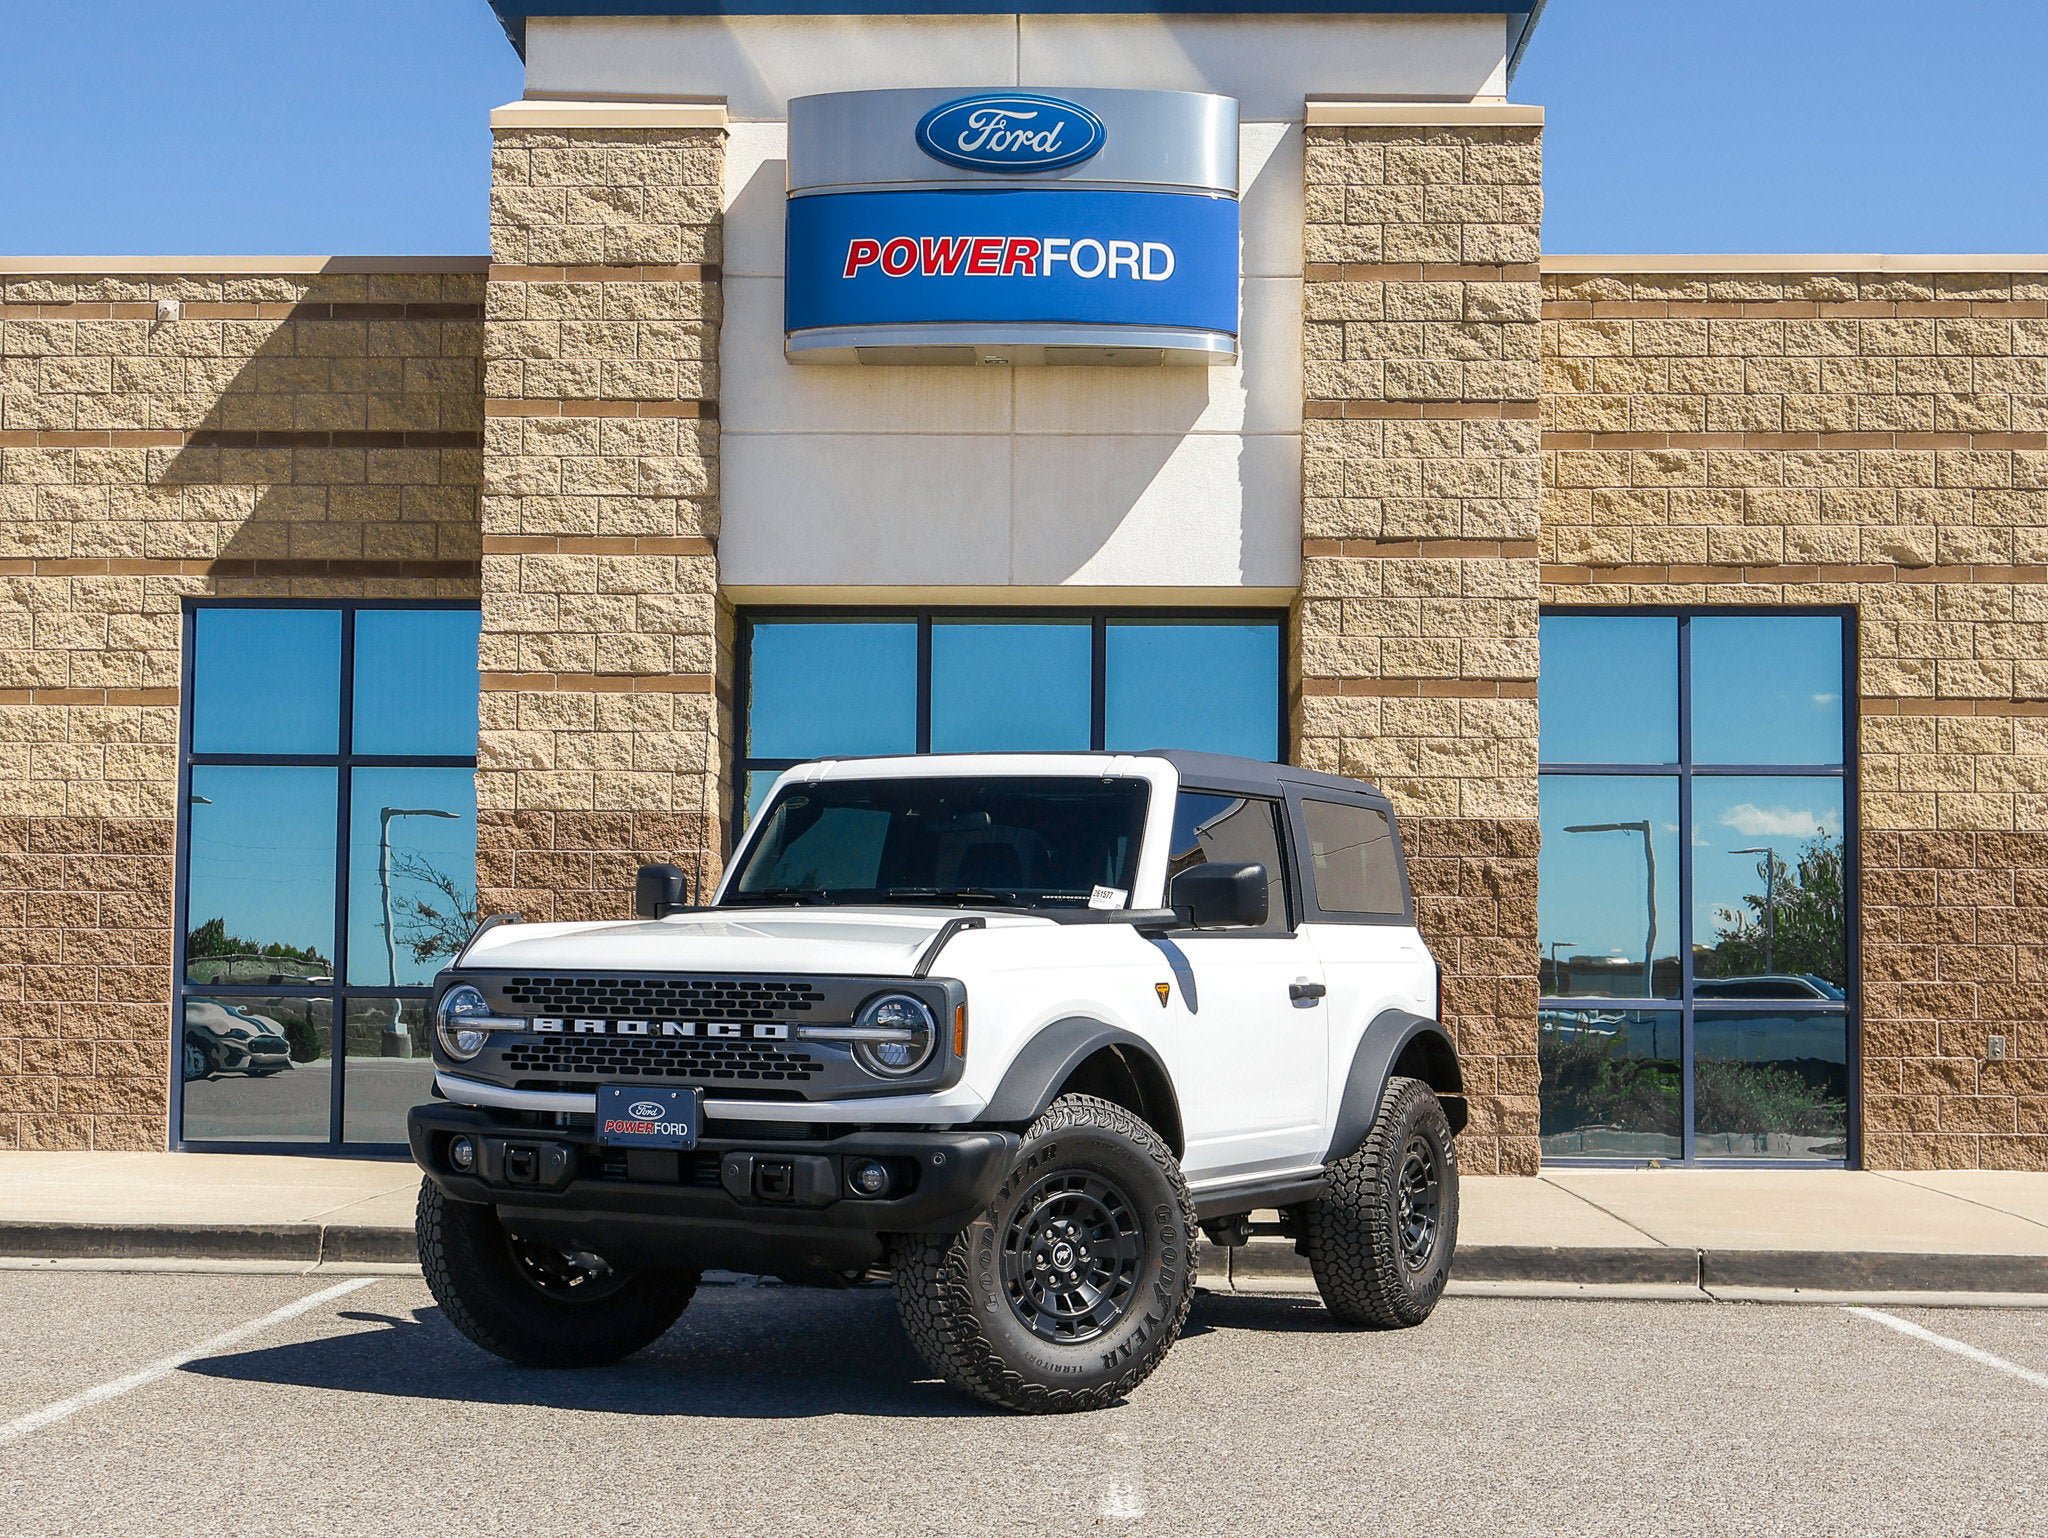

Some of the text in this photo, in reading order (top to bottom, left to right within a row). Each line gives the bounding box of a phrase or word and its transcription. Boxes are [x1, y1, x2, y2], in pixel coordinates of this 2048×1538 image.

[957, 108, 1065, 153] Ford
[532, 1017, 789, 1039] BRONCO
[635, 1104, 658, 1117] Ford
